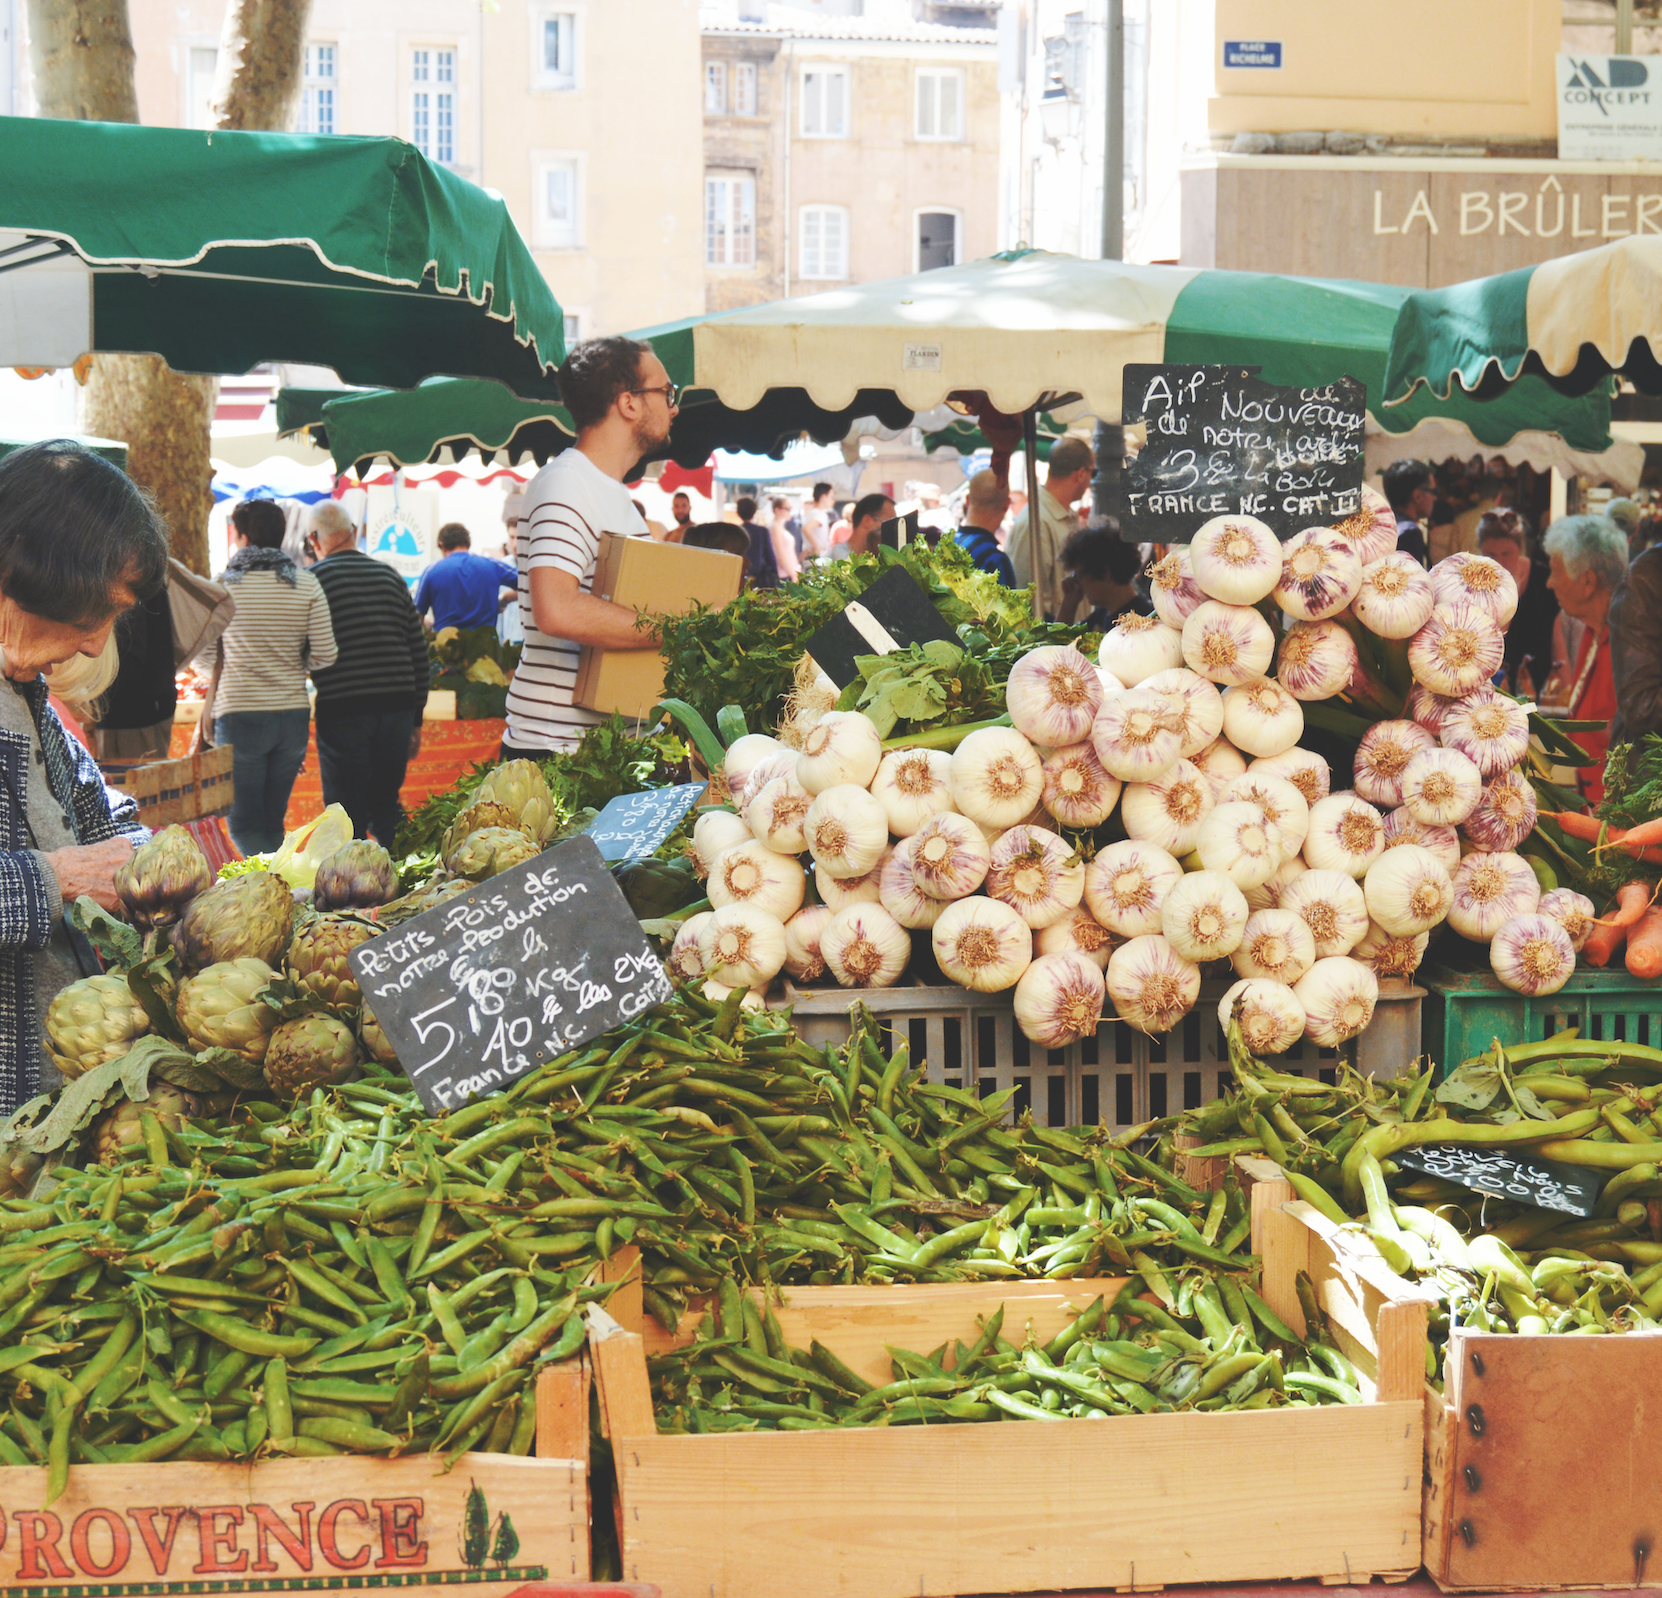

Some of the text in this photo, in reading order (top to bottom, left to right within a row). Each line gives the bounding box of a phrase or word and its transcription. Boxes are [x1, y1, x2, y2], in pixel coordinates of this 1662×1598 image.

[1564, 91, 1651, 104] CONCEPT
[1373, 174, 1662, 238] LA BRÛLER
[1128, 492, 1230, 515] FRANCE
[1282, 490, 1329, 516] CAT
[0, 1497, 430, 1580] ROVENCE
